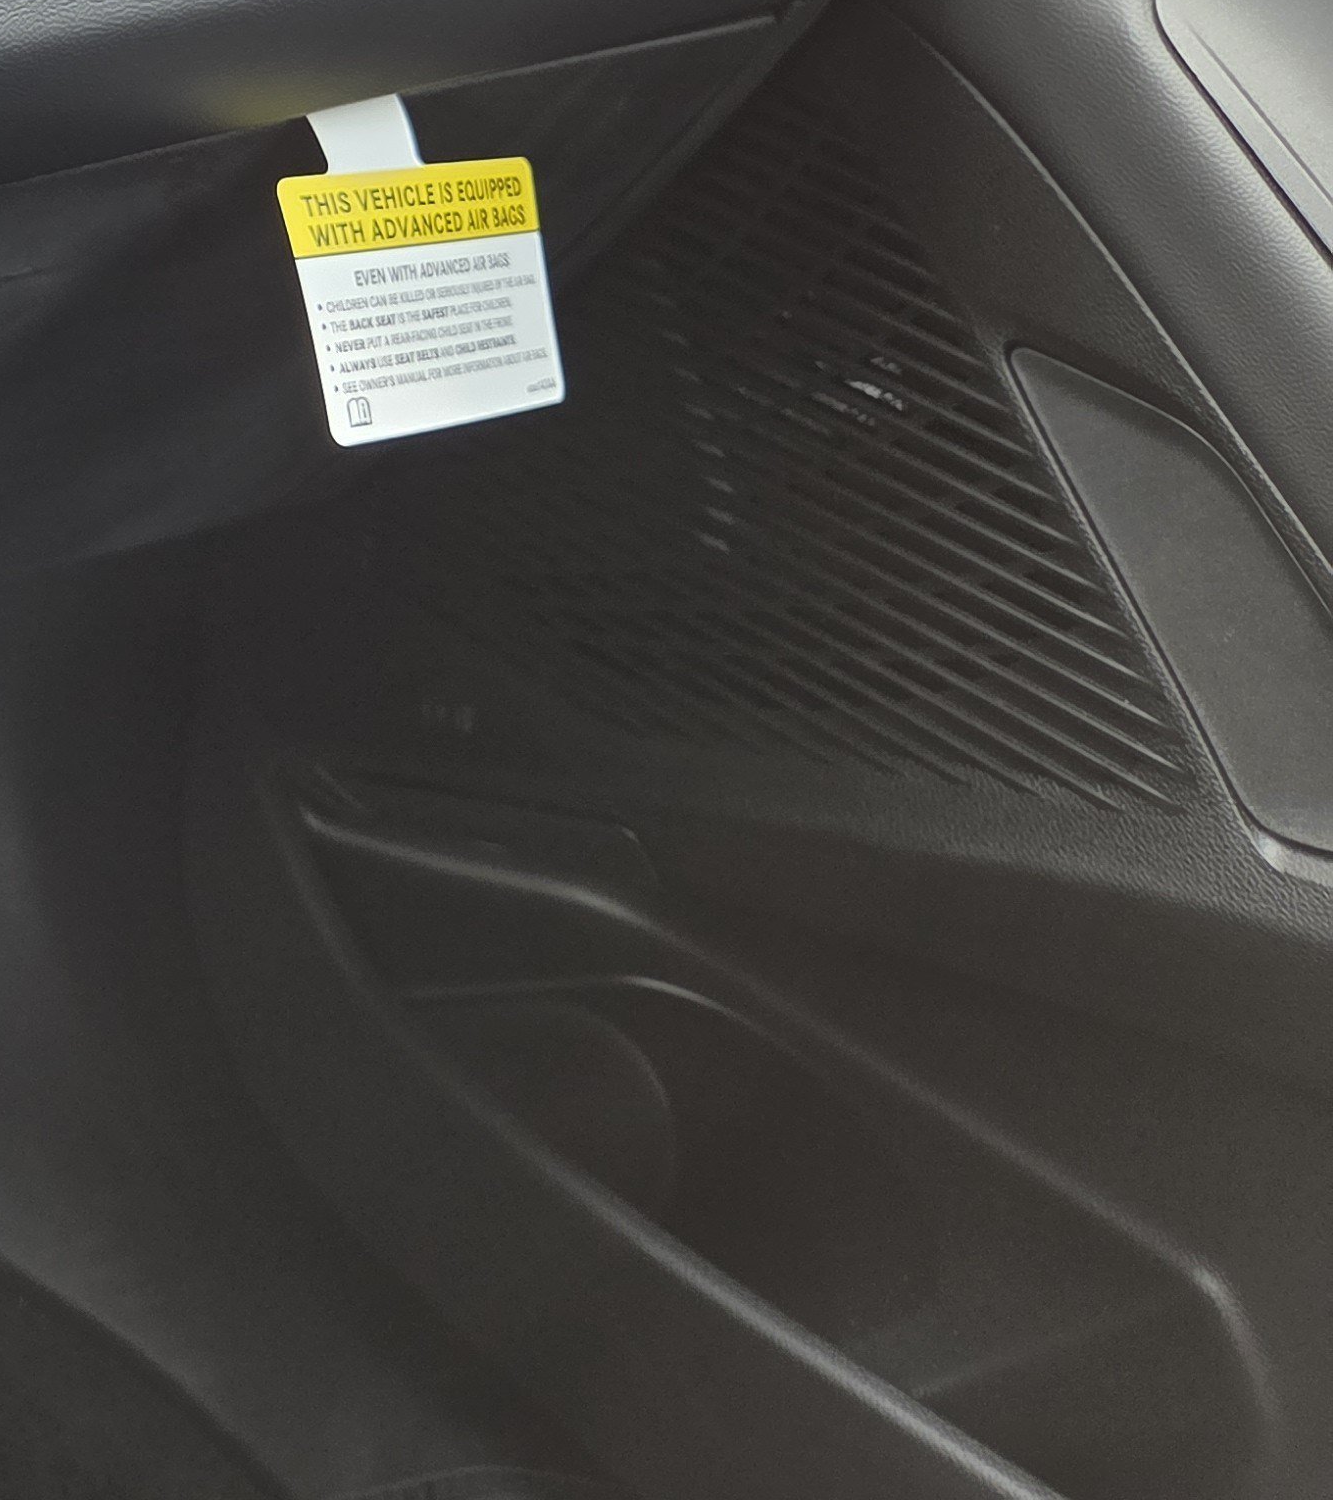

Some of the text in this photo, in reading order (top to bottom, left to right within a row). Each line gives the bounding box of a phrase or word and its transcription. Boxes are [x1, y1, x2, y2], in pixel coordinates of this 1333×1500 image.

[300, 176, 522, 217] THIS VEHICLE IS EQUIPPED
[309, 204, 526, 248] WITH ADVANCED AIR BAGS
[354, 268, 386, 287] EVEN
[388, 264, 418, 282] WITH
[419, 257, 470, 278] ADVANCED
[326, 297, 368, 313] CHILDREN
[369, 295, 387, 307] CAN
[330, 320, 348, 333] THE
[349, 316, 374, 330] BACK
[375, 313, 397, 327] SEAT
[422, 305, 449, 319] SAFEST
[335, 338, 366, 354] NEVER
[338, 358, 377, 374] ALWAYS
[394, 351, 416, 365] SEAT
[342, 381, 358, 394] SEE
